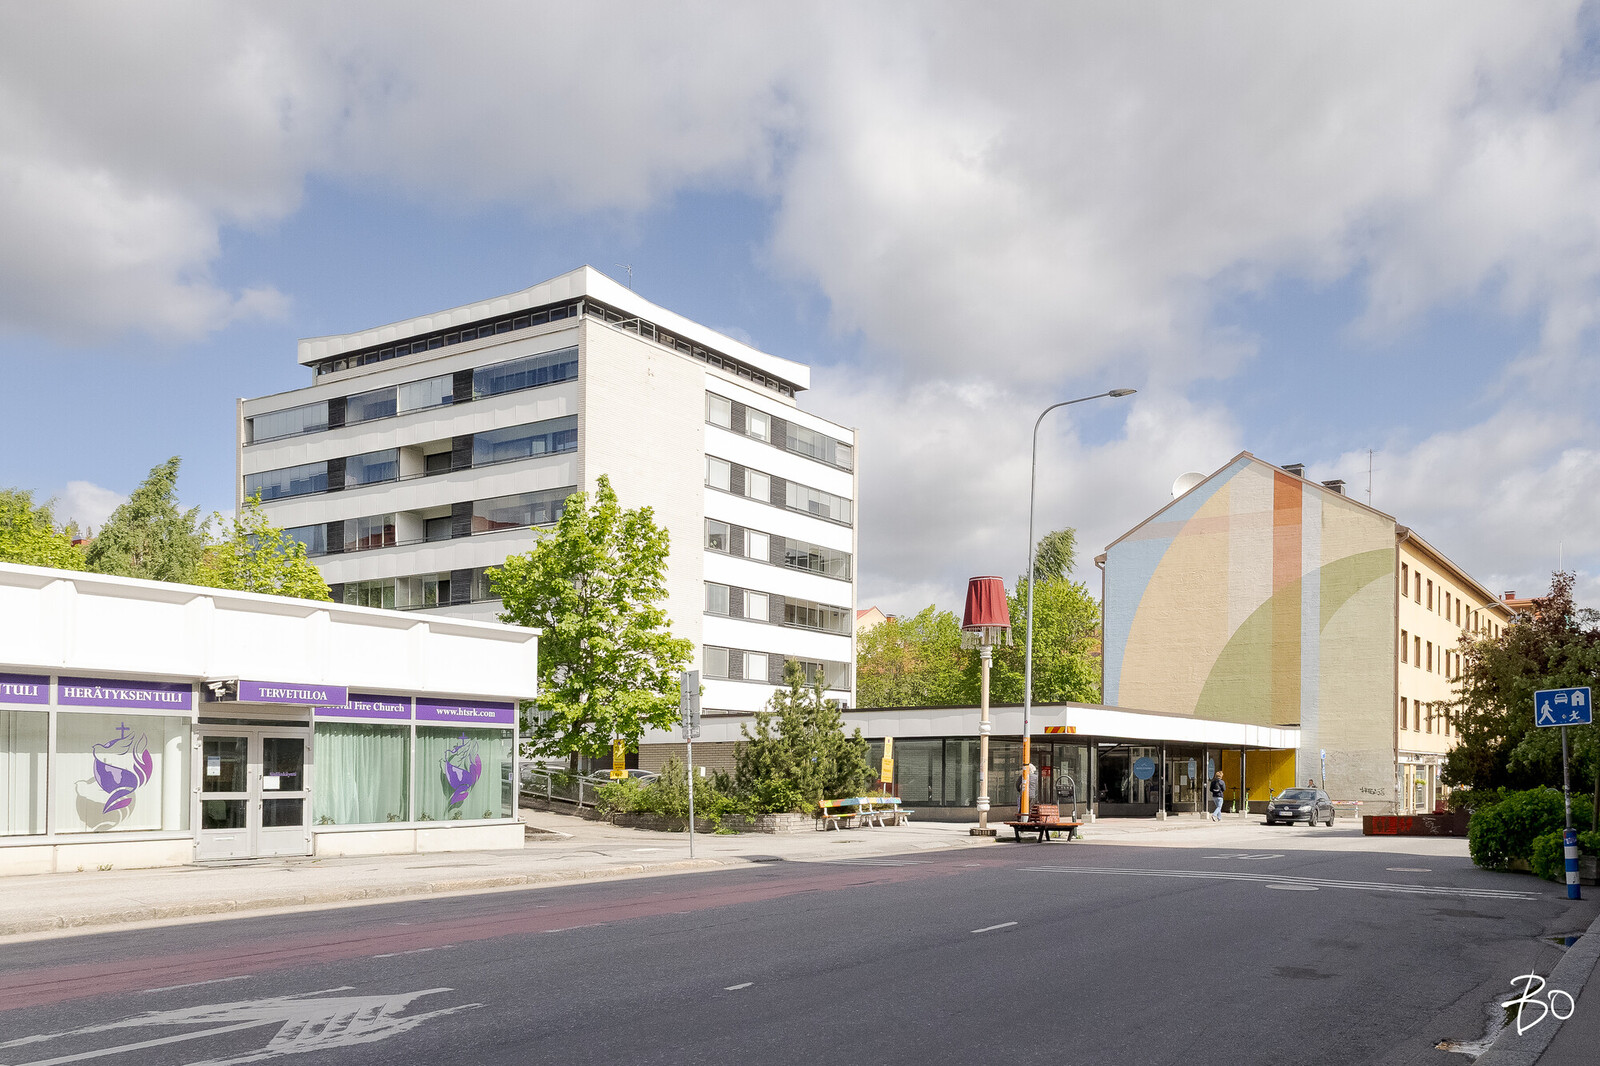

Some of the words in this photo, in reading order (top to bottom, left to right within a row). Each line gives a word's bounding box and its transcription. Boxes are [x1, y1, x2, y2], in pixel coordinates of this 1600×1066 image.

[0, 684, 38, 696] TULI
[259, 687, 327, 701] TERVETULOA
[354, 701, 371, 710] Fire
[373, 703, 405, 712] Church
[436, 707, 496, 718] www.htsrk.com
